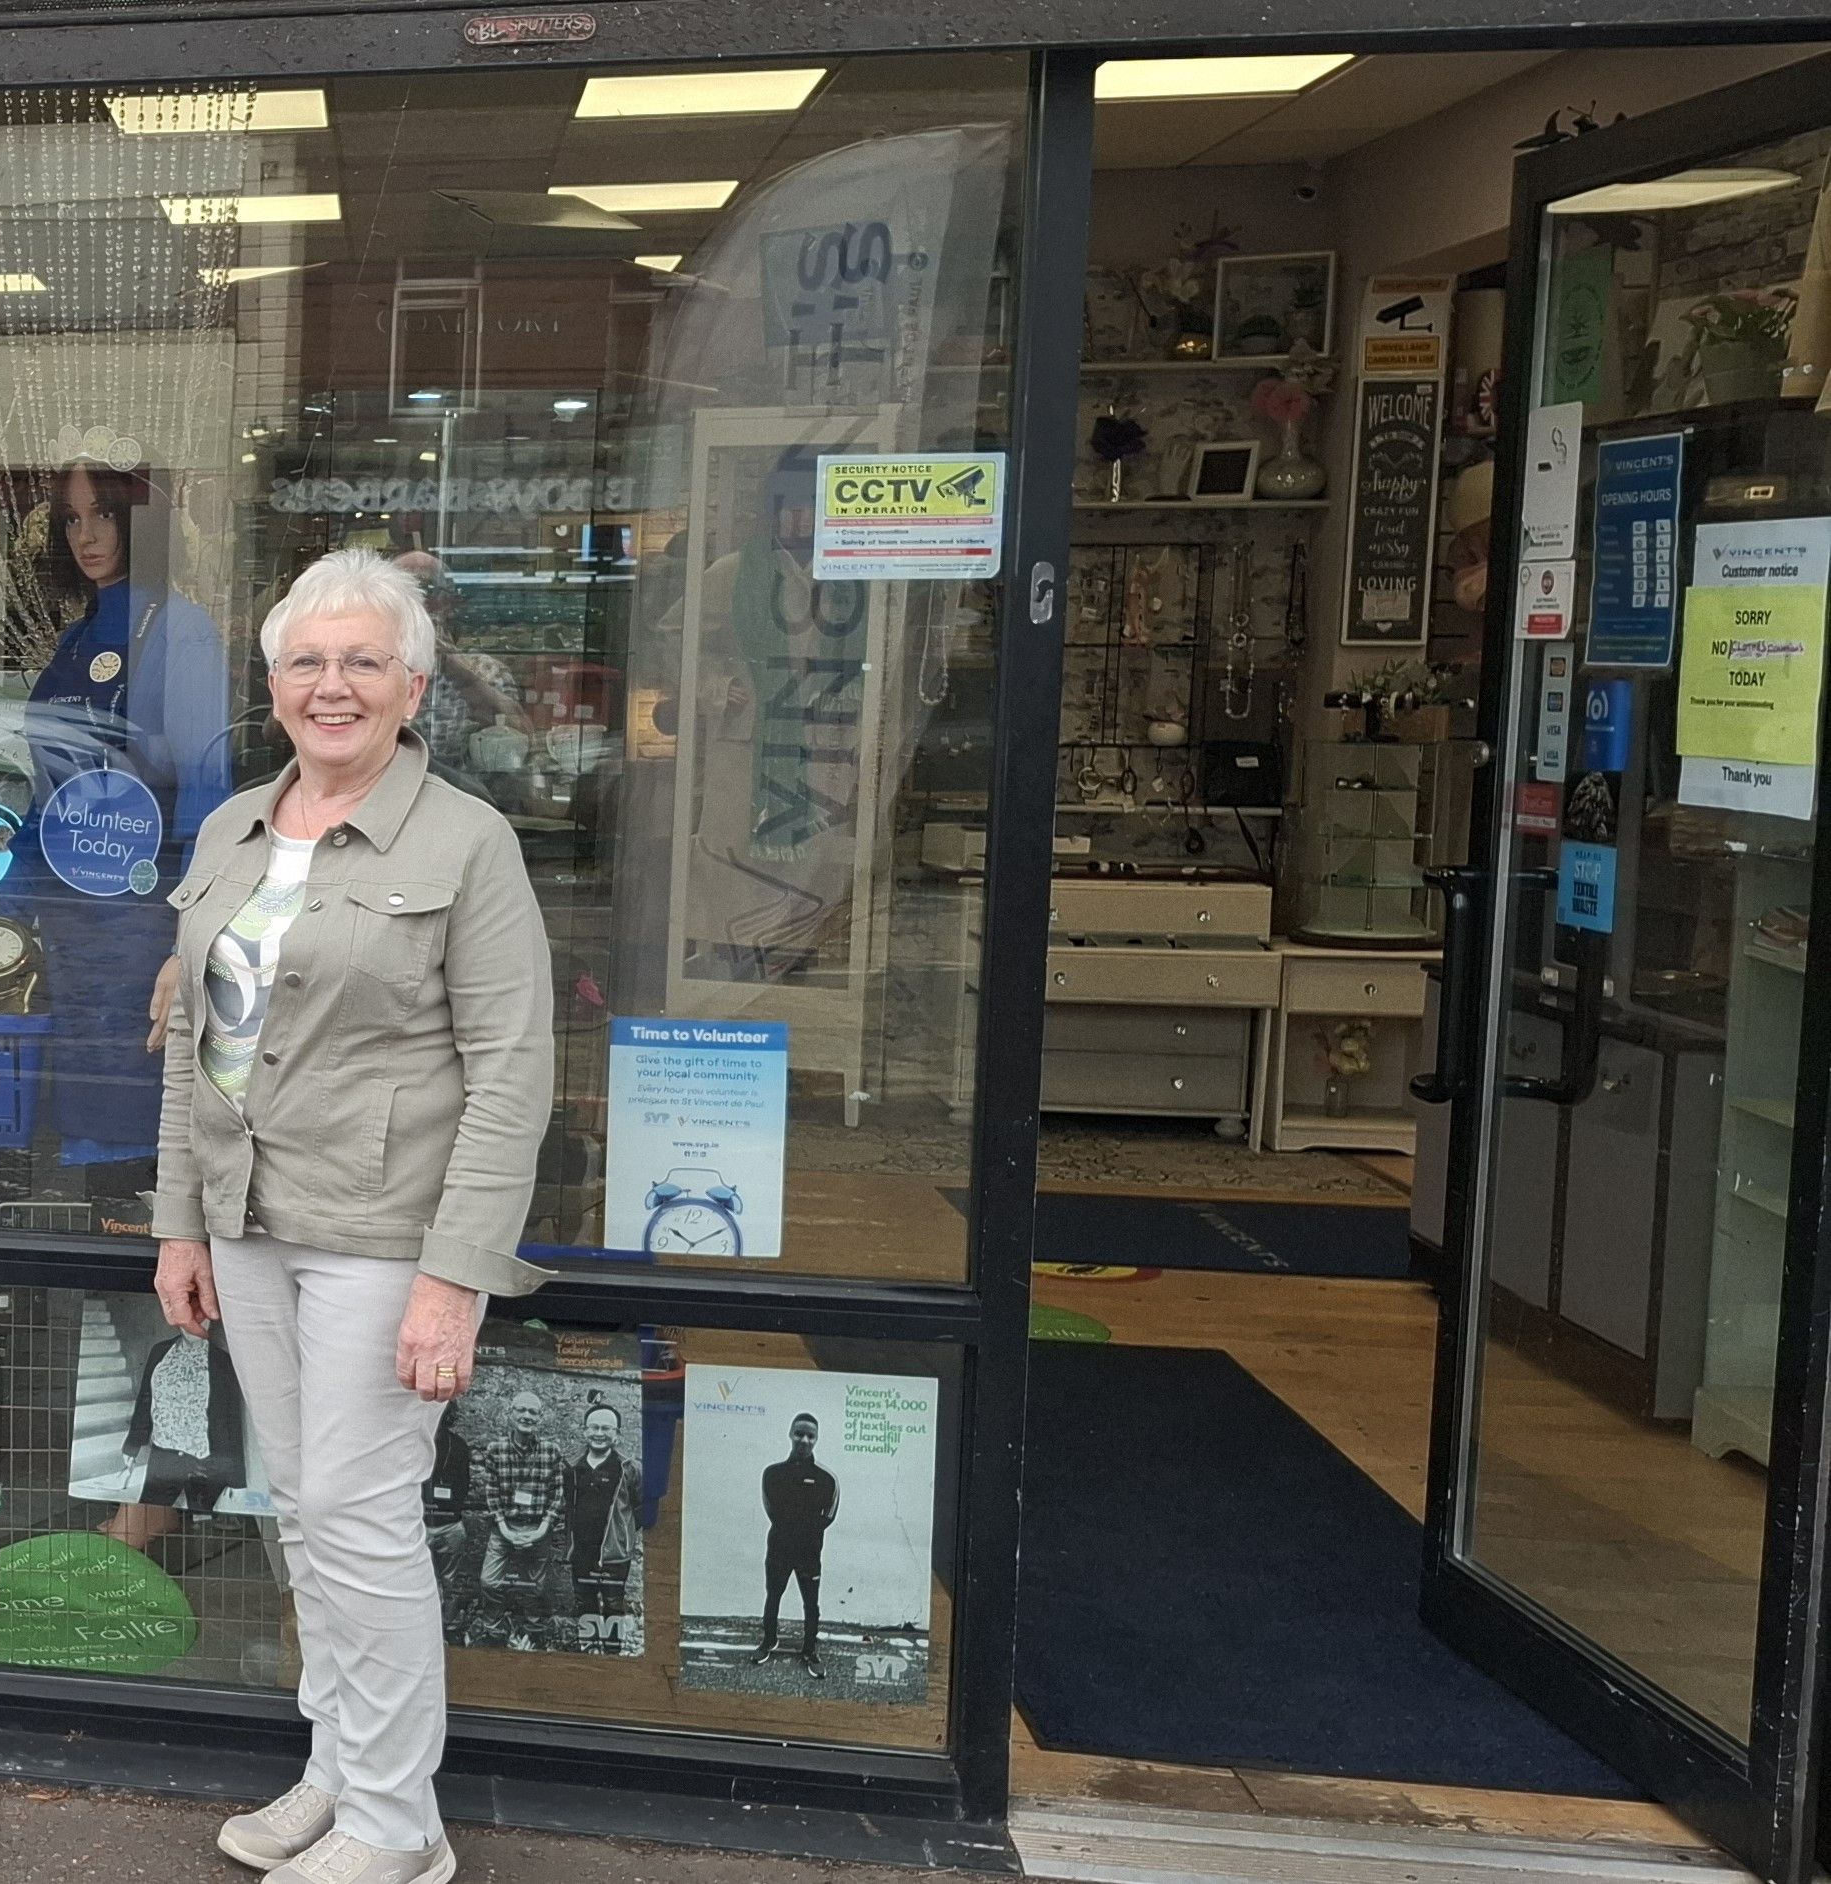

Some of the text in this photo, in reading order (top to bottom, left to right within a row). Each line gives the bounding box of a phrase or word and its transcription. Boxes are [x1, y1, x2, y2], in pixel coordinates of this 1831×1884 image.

[508, 16, 583, 33] SHUTTERS
[1368, 392, 1433, 432] WELCOME
[835, 464, 933, 475] SECURITY NOTICE
[1615, 453, 1674, 471] VINCENT'S
[834, 477, 933, 504] CCTV
[1373, 469, 1419, 501] happy
[1602, 487, 1672, 507] OPENING HOURS
[835, 505, 929, 515] IN OPERATION
[866, 528, 910, 537] prevention
[841, 537, 986, 547] Safety of members and visitors
[1728, 545, 1807, 559] VINCENT'S
[821, 562, 887, 573] VINCENT'S
[1721, 563, 1799, 579] Customer notice
[1357, 574, 1417, 593] LOVING
[1735, 609, 1772, 626] SORRY
[1711, 640, 1728, 656] NO
[1729, 670, 1767, 687] TODAY
[1546, 724, 1561, 737] VISA
[1721, 766, 1773, 787] Thank you
[55, 801, 153, 836] Volunteer
[69, 828, 135, 867] Today
[1573, 860, 1602, 880] STOP
[1572, 898, 1598, 917] WASTE
[630, 1025, 770, 1045] Time to Volunteer
[636, 1054, 763, 1070] Give the gift of time to
[636, 1068, 761, 1083] your local community.
[637, 1084, 750, 1098] Every hour you volunteer
[670, 1096, 743, 1108] to St Vincent de
[643, 1111, 671, 1125] SVP
[683, 1208, 704, 1225] 12
[657, 1235, 730, 1254] 9 3
[845, 1384, 902, 1400] Vincent's
[692, 1401, 767, 1415] VINCENT'S
[845, 1397, 929, 1413] keeps 14,000
[844, 1408, 887, 1421] tonnes
[843, 1420, 927, 1435] of textiles out
[843, 1430, 902, 1445] of landfill
[843, 1442, 899, 1458] annually
[579, 1613, 637, 1639] SVP
[854, 1653, 909, 1681] SVP
